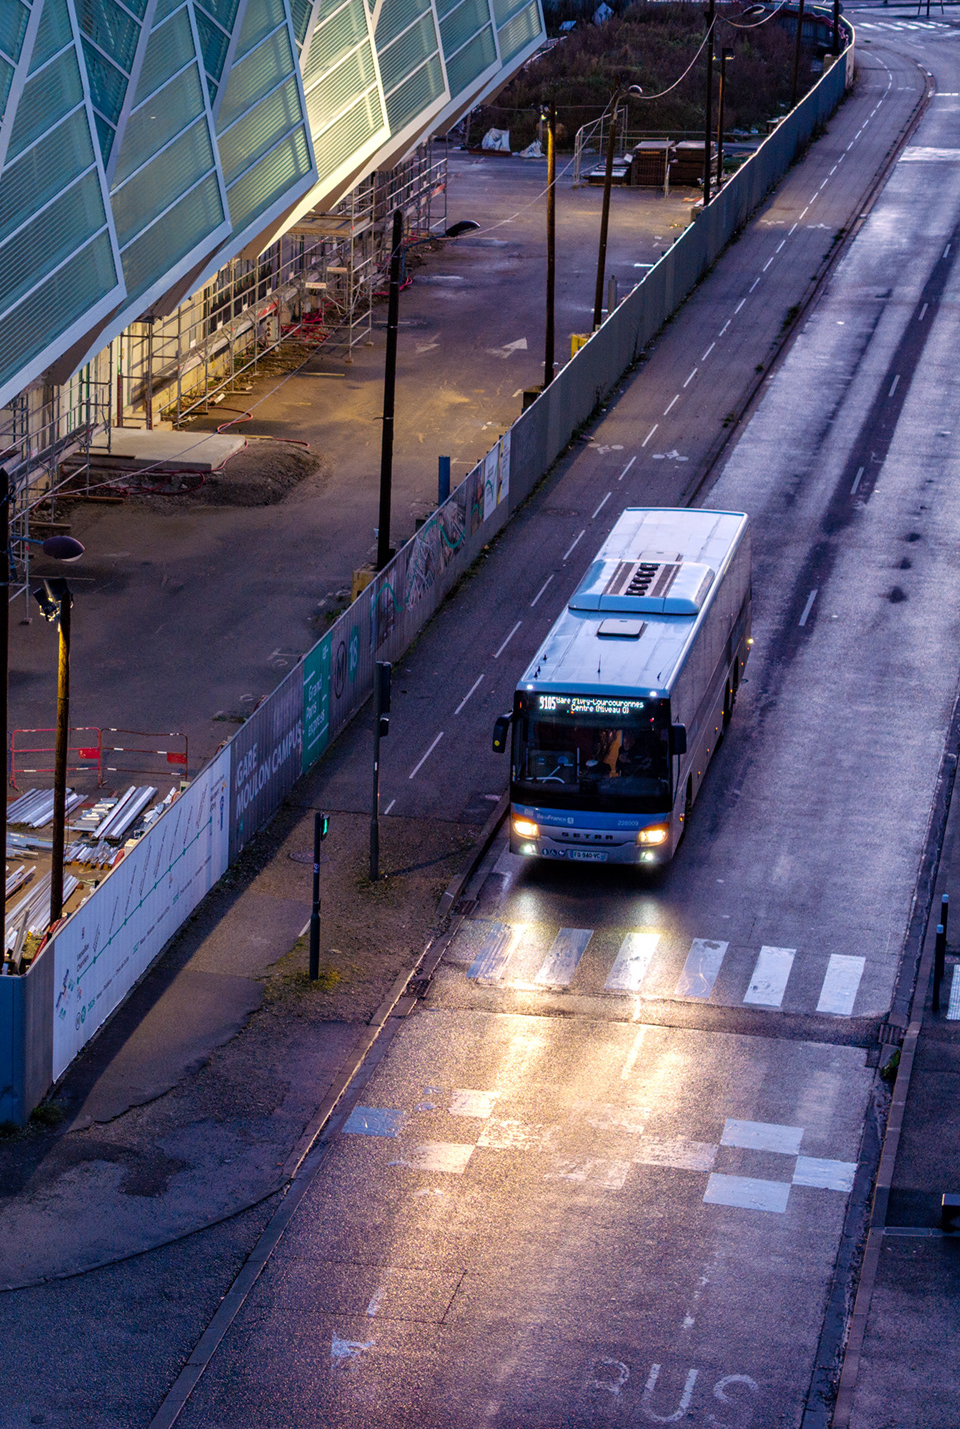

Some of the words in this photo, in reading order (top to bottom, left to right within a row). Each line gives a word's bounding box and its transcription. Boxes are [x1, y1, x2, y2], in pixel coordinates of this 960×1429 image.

[350, 635, 358, 671] 18
[309, 673, 323, 701] Grand
[306, 701, 317, 722] Paris
[539, 696, 556, 710] 9105
[571, 704, 594, 712] Centre
[236, 742, 258, 787] GARE
[236, 756, 272, 819] MOULON
[272, 721, 302, 774] CAMPUS
[562, 832, 614, 840] SETRA
